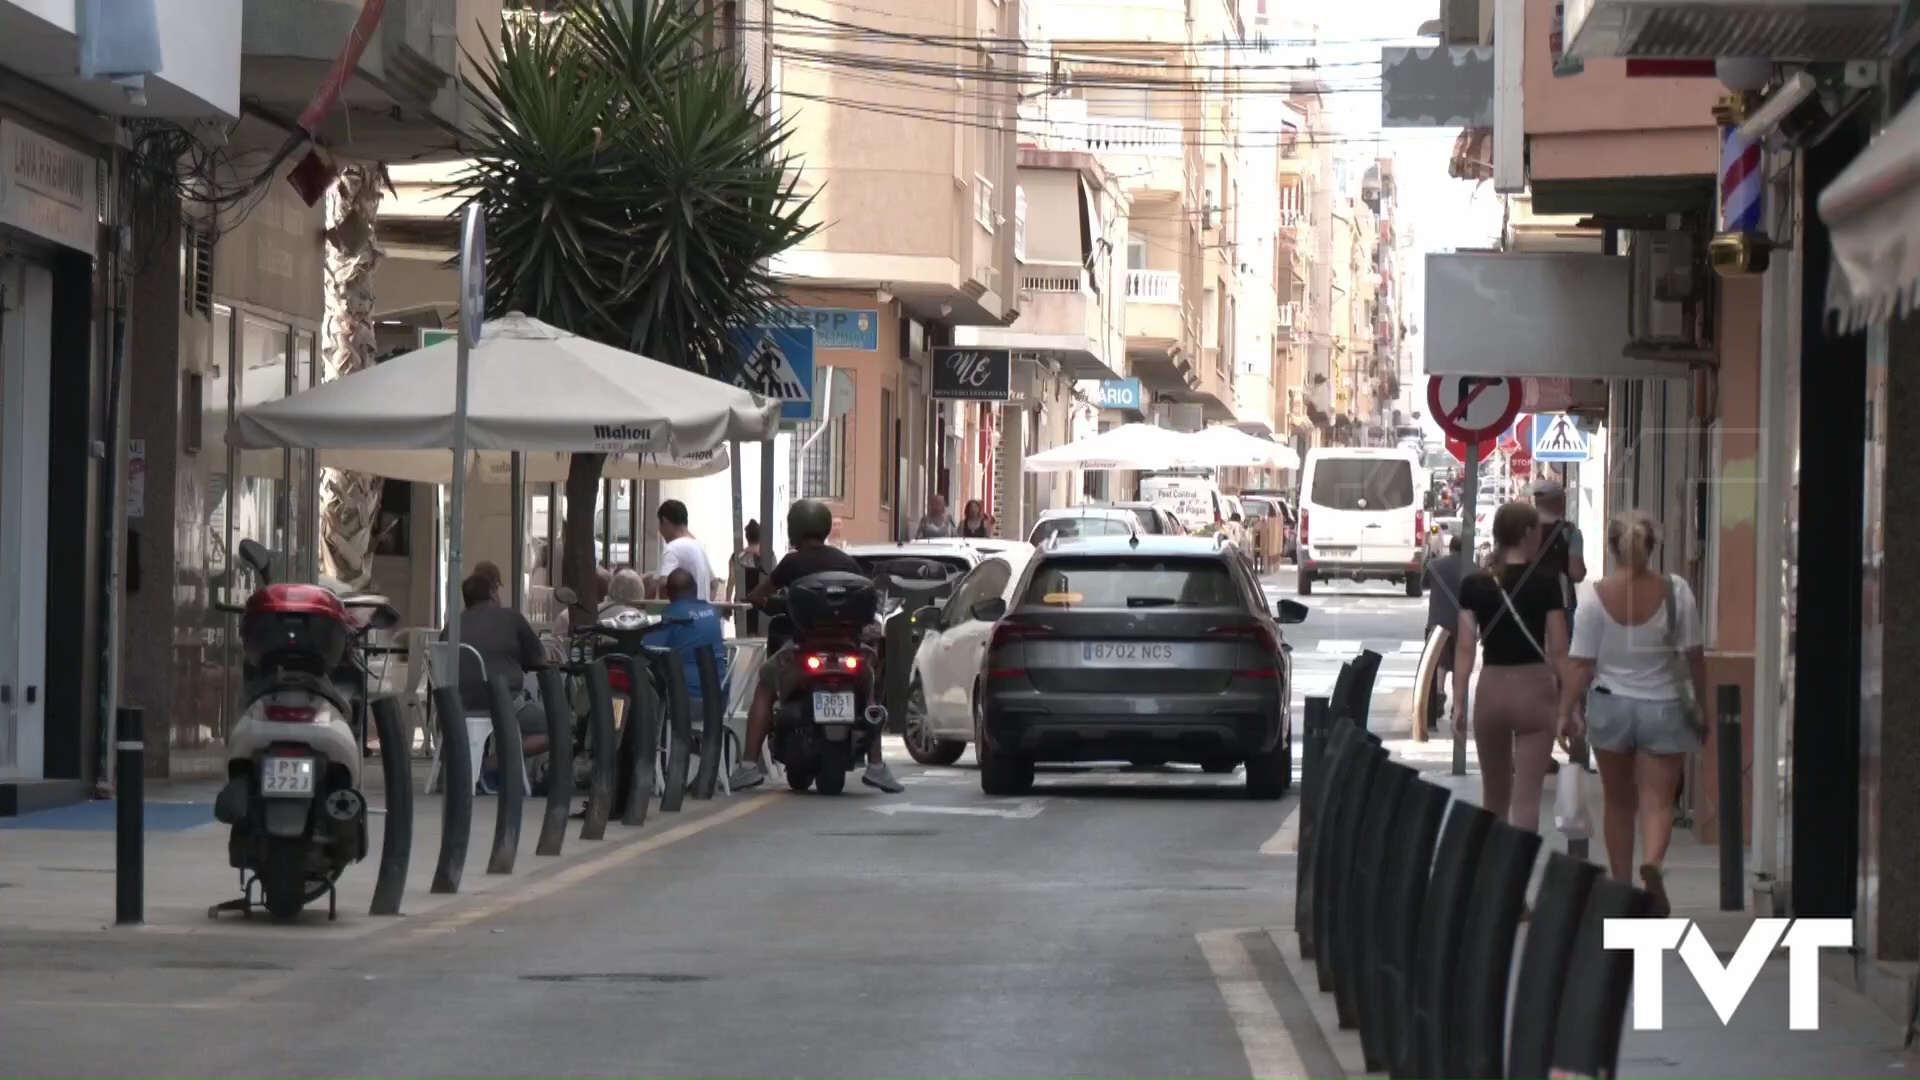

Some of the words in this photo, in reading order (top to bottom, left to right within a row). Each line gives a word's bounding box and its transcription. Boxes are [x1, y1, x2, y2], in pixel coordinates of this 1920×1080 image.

[15, 135, 37, 179] LAVA
[39, 146, 84, 202] PREMIUM
[1100, 387, 1133, 405] ARIO
[593, 424, 651, 441] Mahou
[1173, 489, 1197, 498] Control
[1095, 644, 1136, 659] 8702
[1141, 644, 1173, 659] NCS
[280, 761, 299, 774] PY
[267, 776, 309, 790] 272J
